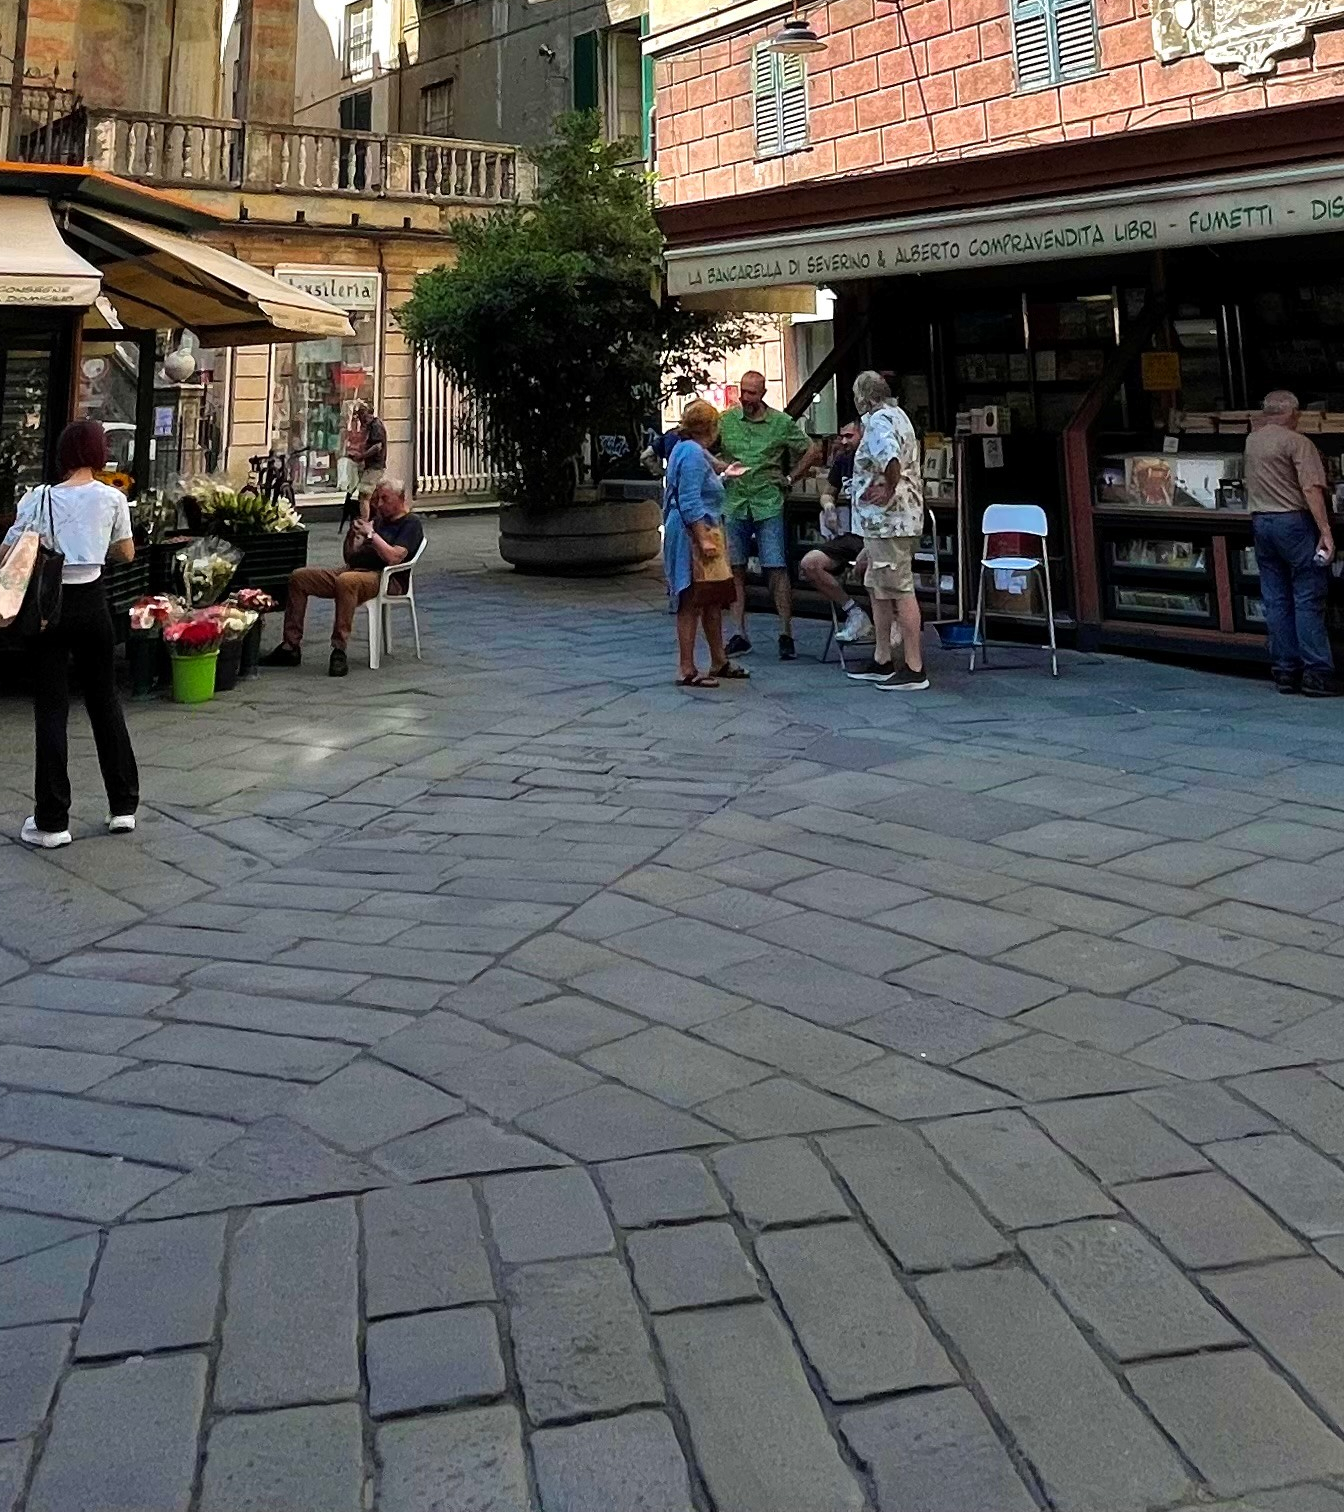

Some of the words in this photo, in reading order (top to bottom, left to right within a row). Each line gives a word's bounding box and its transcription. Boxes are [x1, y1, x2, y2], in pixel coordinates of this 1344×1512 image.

[688, 271, 703, 285] LA
[707, 261, 783, 284] BANCARELLA
[789, 259, 802, 276] DI
[807, 253, 871, 275] SEVERINO
[877, 249, 887, 269] &
[895, 240, 961, 264] ALBERTO
[968, 224, 1105, 257] COMPRAVENDITA
[1114, 219, 1157, 243] LIBRI
[1188, 204, 1273, 234] FUMETTI
